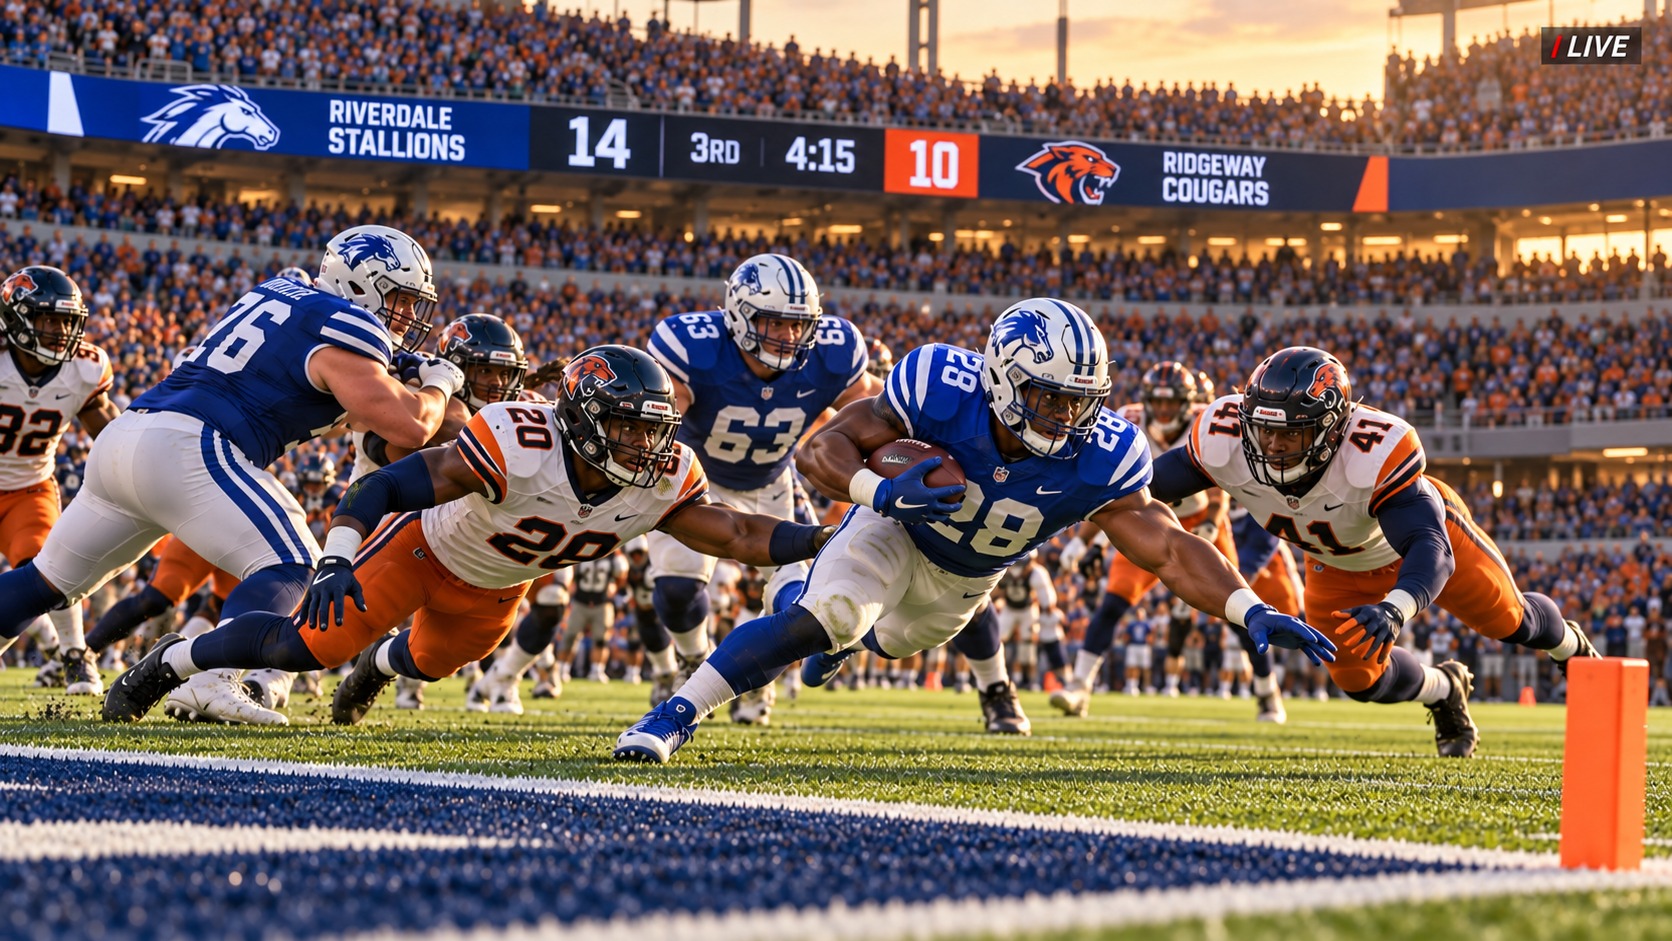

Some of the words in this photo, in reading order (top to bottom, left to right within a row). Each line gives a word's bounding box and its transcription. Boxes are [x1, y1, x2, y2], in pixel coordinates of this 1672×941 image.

[329, 98, 453, 131] RIVERDALE
[328, 126, 466, 162] STALLIONS
[568, 115, 631, 169] 14
[690, 132, 740, 165] 3RD
[785, 136, 855, 173] 4:15
[909, 139, 959, 189] 10
[1163, 151, 1267, 178] RIDGEWAY
[1162, 176, 1269, 206] COUGARS
[184, 291, 292, 375] 76
[679, 313, 720, 340] 63
[941, 348, 983, 394] 28
[505, 407, 554, 451] 20
[703, 405, 807, 465] 63
[1086, 412, 1129, 452] 28
[1348, 418, 1394, 454] 41
[925, 479, 1045, 558] 28
[1264, 512, 1366, 556] 41
